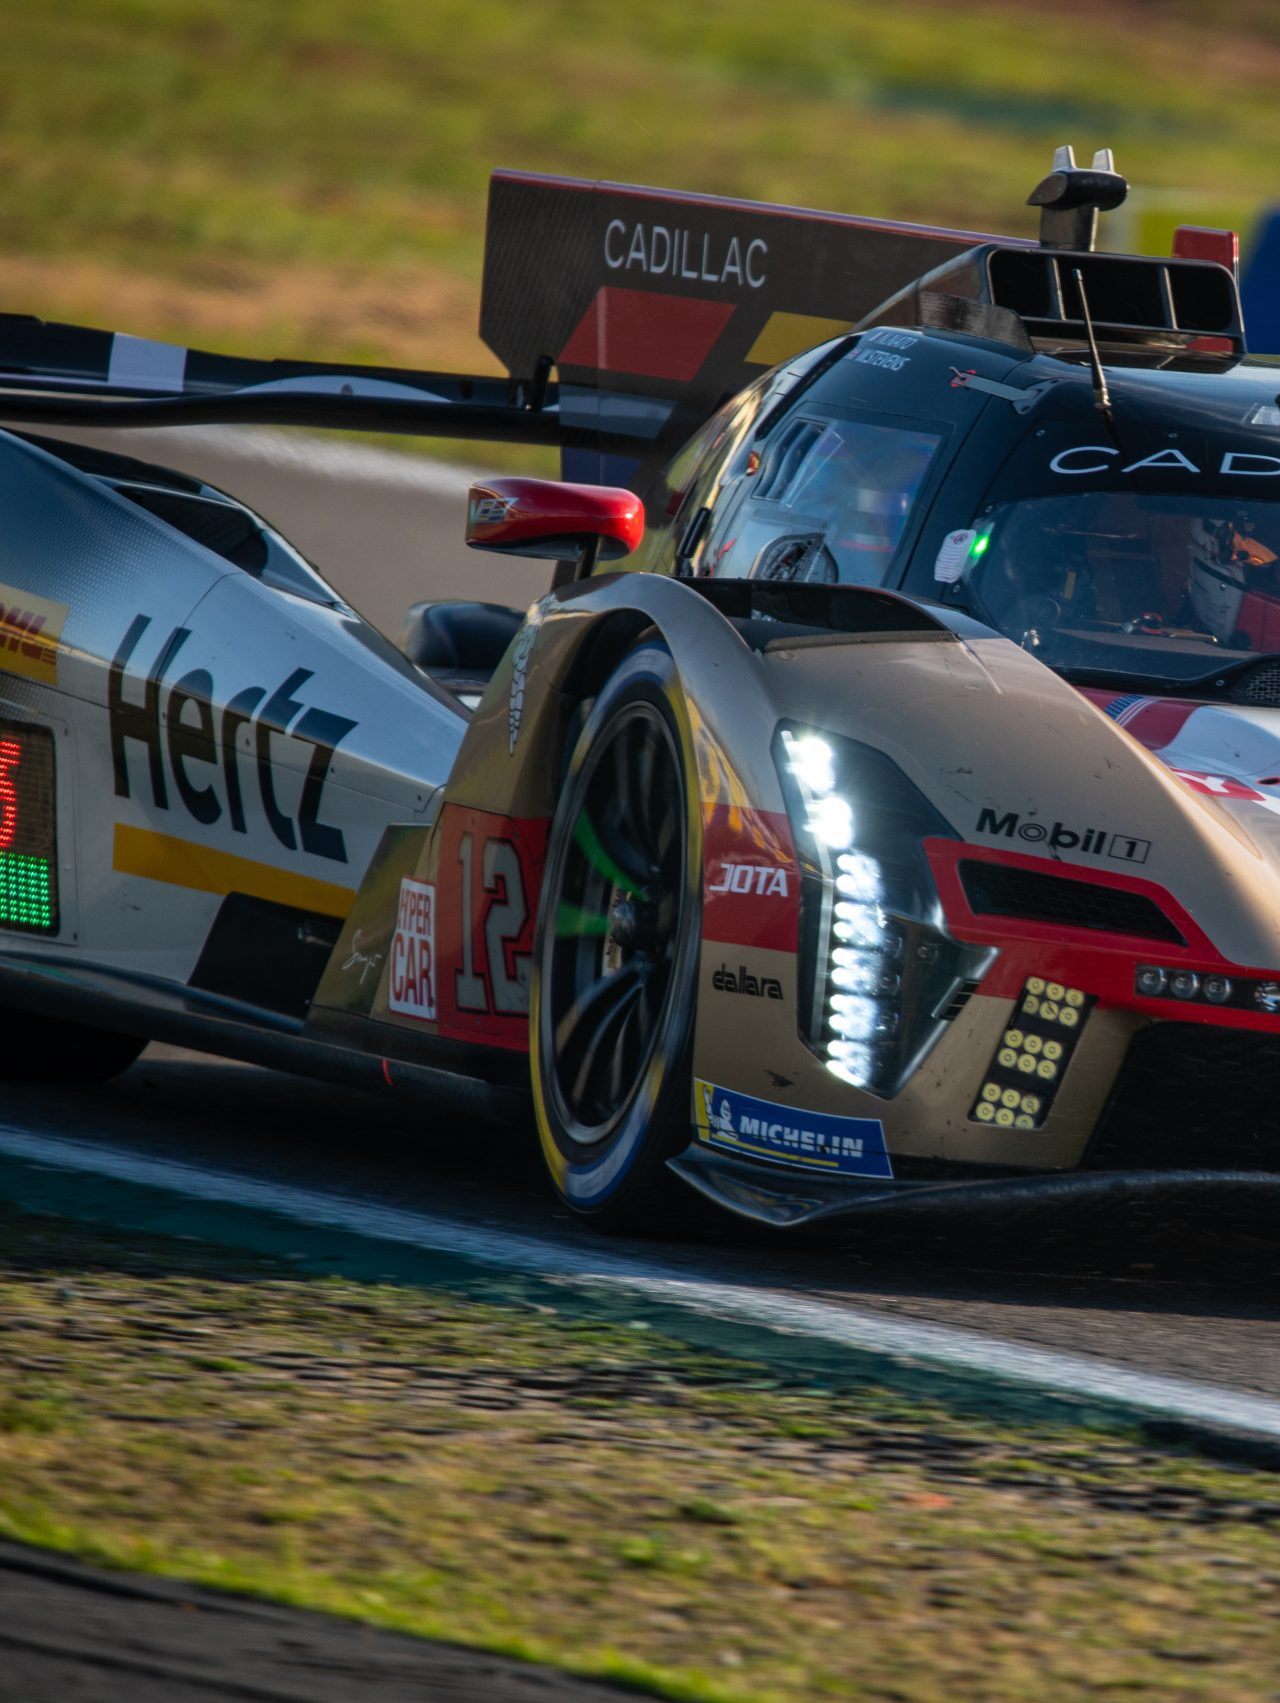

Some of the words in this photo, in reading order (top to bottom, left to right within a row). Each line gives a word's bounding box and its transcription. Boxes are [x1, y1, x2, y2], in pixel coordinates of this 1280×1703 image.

[604, 219, 768, 288] CADILLAC
[108, 613, 359, 864] Hertz
[975, 808, 1108, 855] Mobil
[709, 863, 788, 897] JOTA
[455, 831, 531, 1018] 12
[390, 932, 434, 1008] CAR
[712, 963, 783, 1000] dallara
[739, 1115, 864, 1158] MICHELIN
